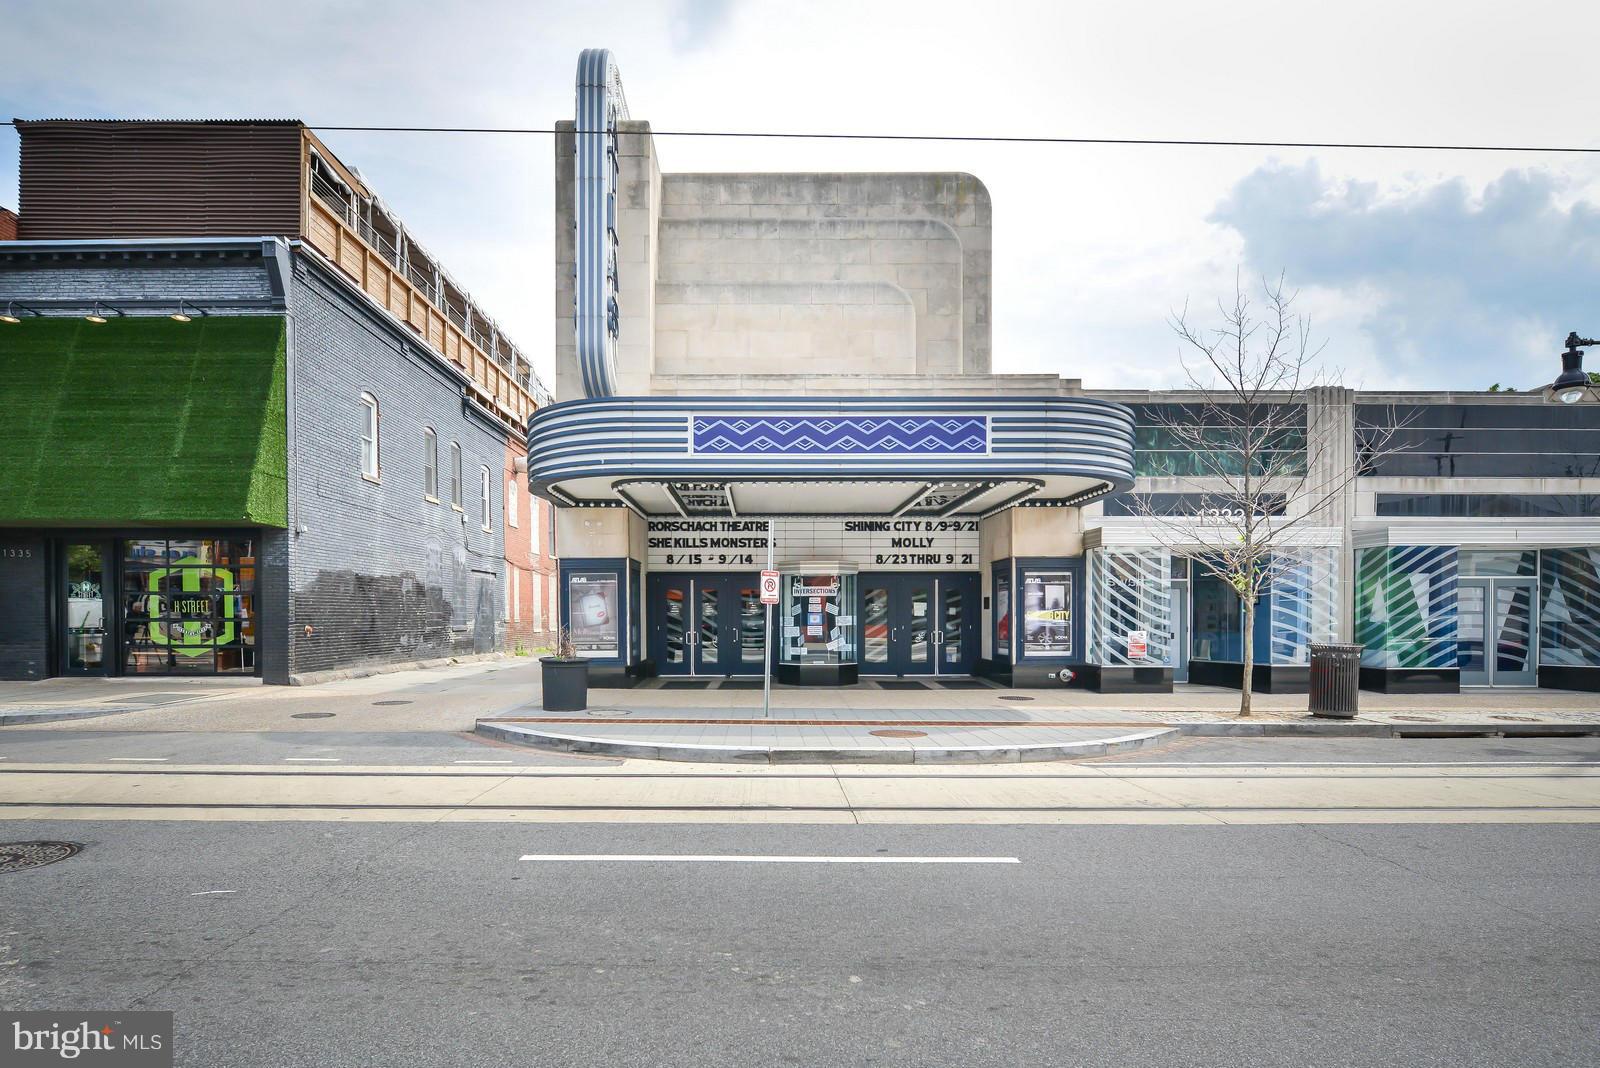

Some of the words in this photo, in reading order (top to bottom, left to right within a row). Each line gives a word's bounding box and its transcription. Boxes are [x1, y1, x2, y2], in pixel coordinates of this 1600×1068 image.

[648, 521, 718, 532] RORSCHACH
[720, 521, 769, 532] THEATRE
[845, 521, 890, 531] SHINING
[893, 521, 921, 531] CITY
[648, 538, 671, 548] SHE
[673, 538, 708, 548] KILLS
[891, 538, 935, 548] MOLLY
[2, 549, 32, 558] 1335
[666, 554, 702, 565] 8/15
[718, 554, 754, 565] 9/14
[875, 554, 908, 565] 8/23
[909, 554, 941, 564] THRU
[961, 554, 973, 564] 21
[174, 601, 180, 612] H
[182, 600, 209, 612] STREET
